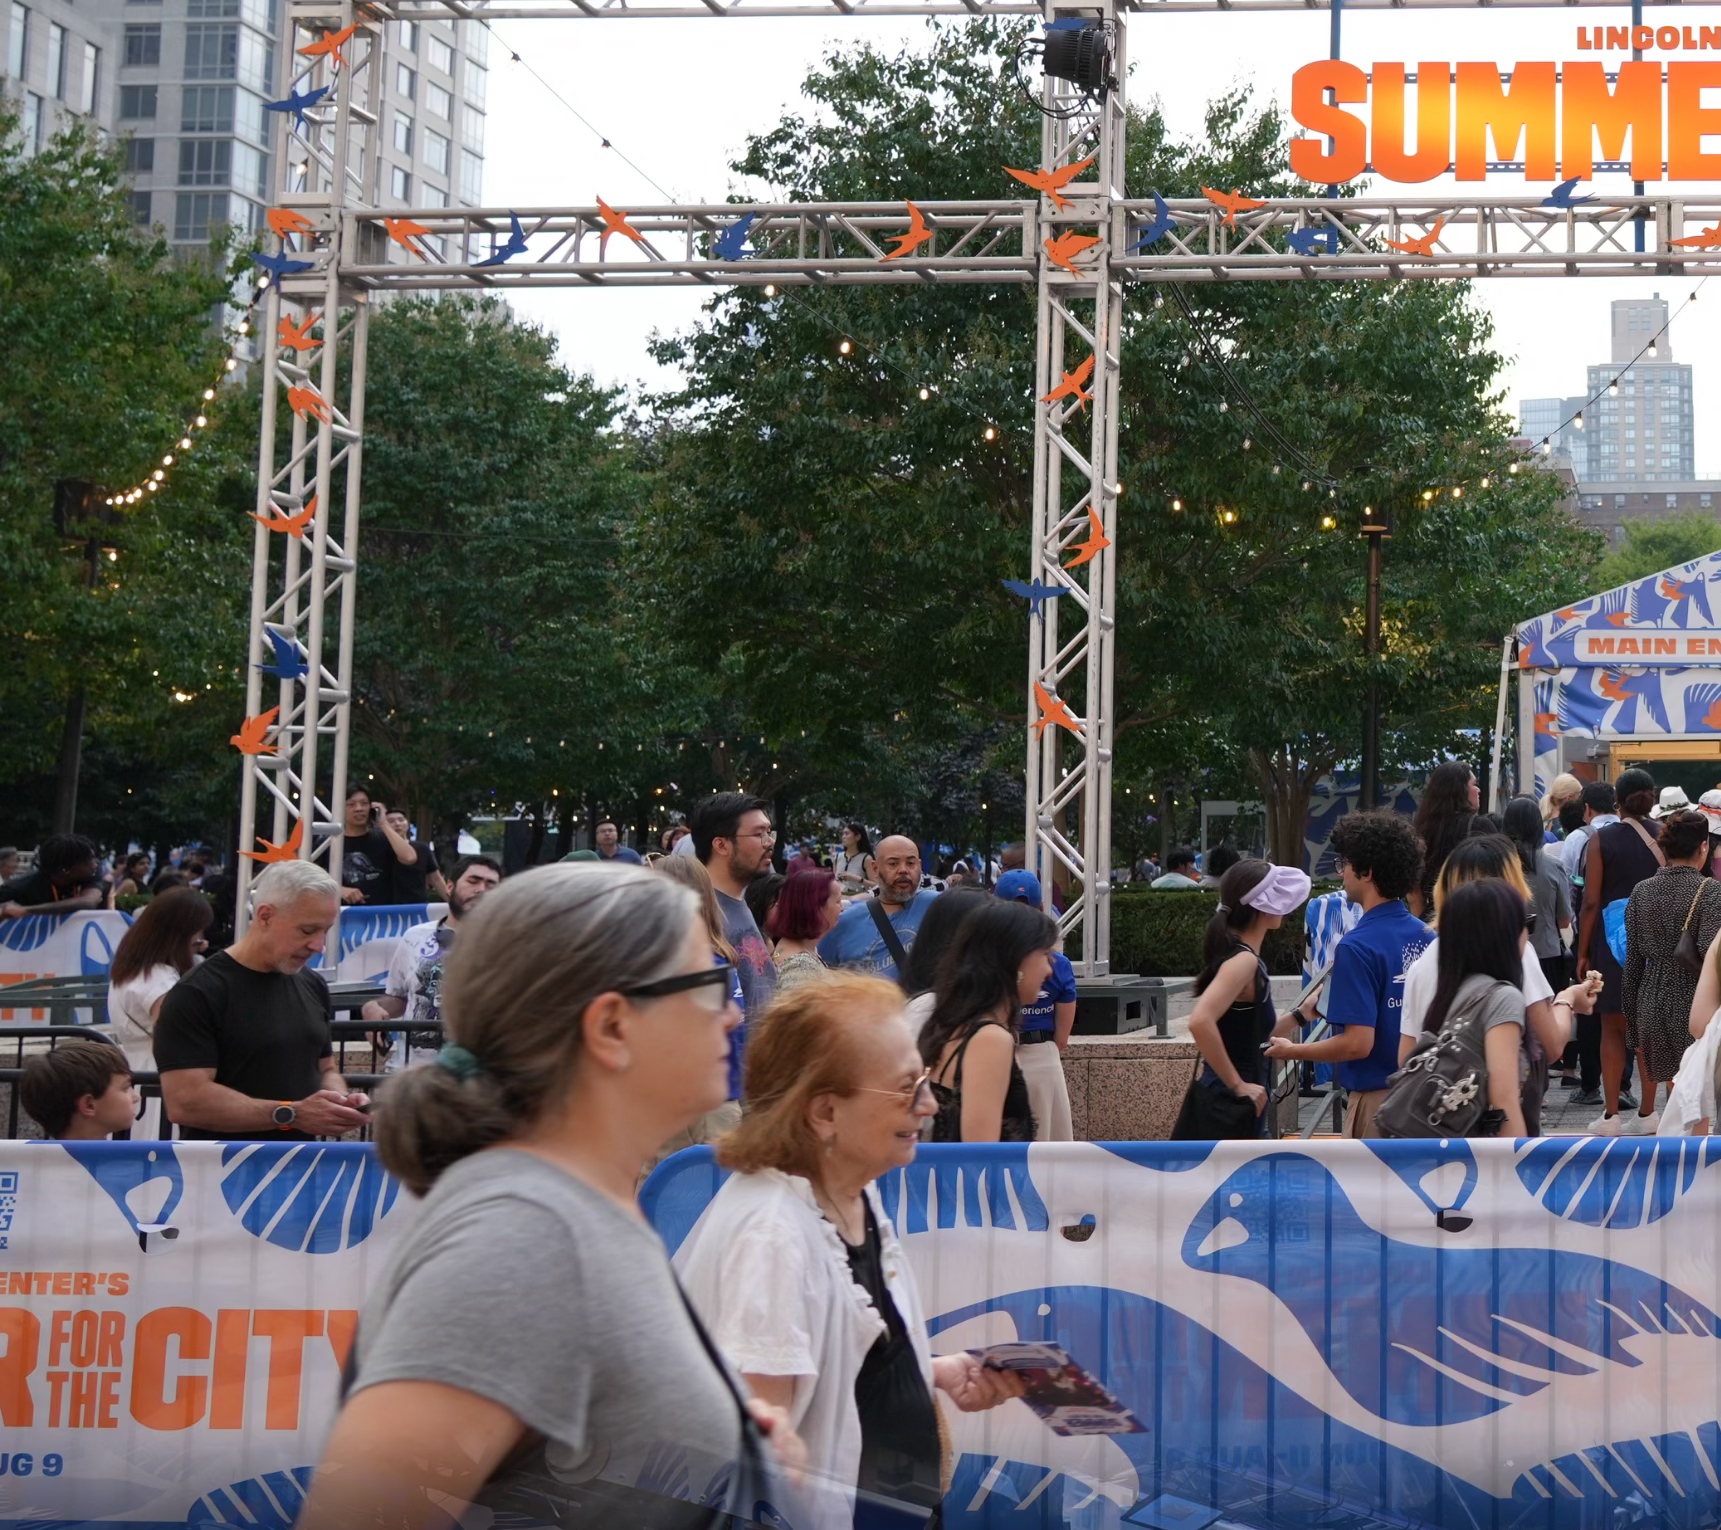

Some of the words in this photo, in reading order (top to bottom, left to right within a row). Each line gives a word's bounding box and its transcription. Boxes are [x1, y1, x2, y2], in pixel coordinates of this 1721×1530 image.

[1577, 25, 1721, 49] LINCOLN
[1587, 637, 1678, 655] MAIN
[48, 1309, 126, 1368] FOR
[46, 1371, 122, 1429] THE
[42, 1453, 64, 1477] 9
